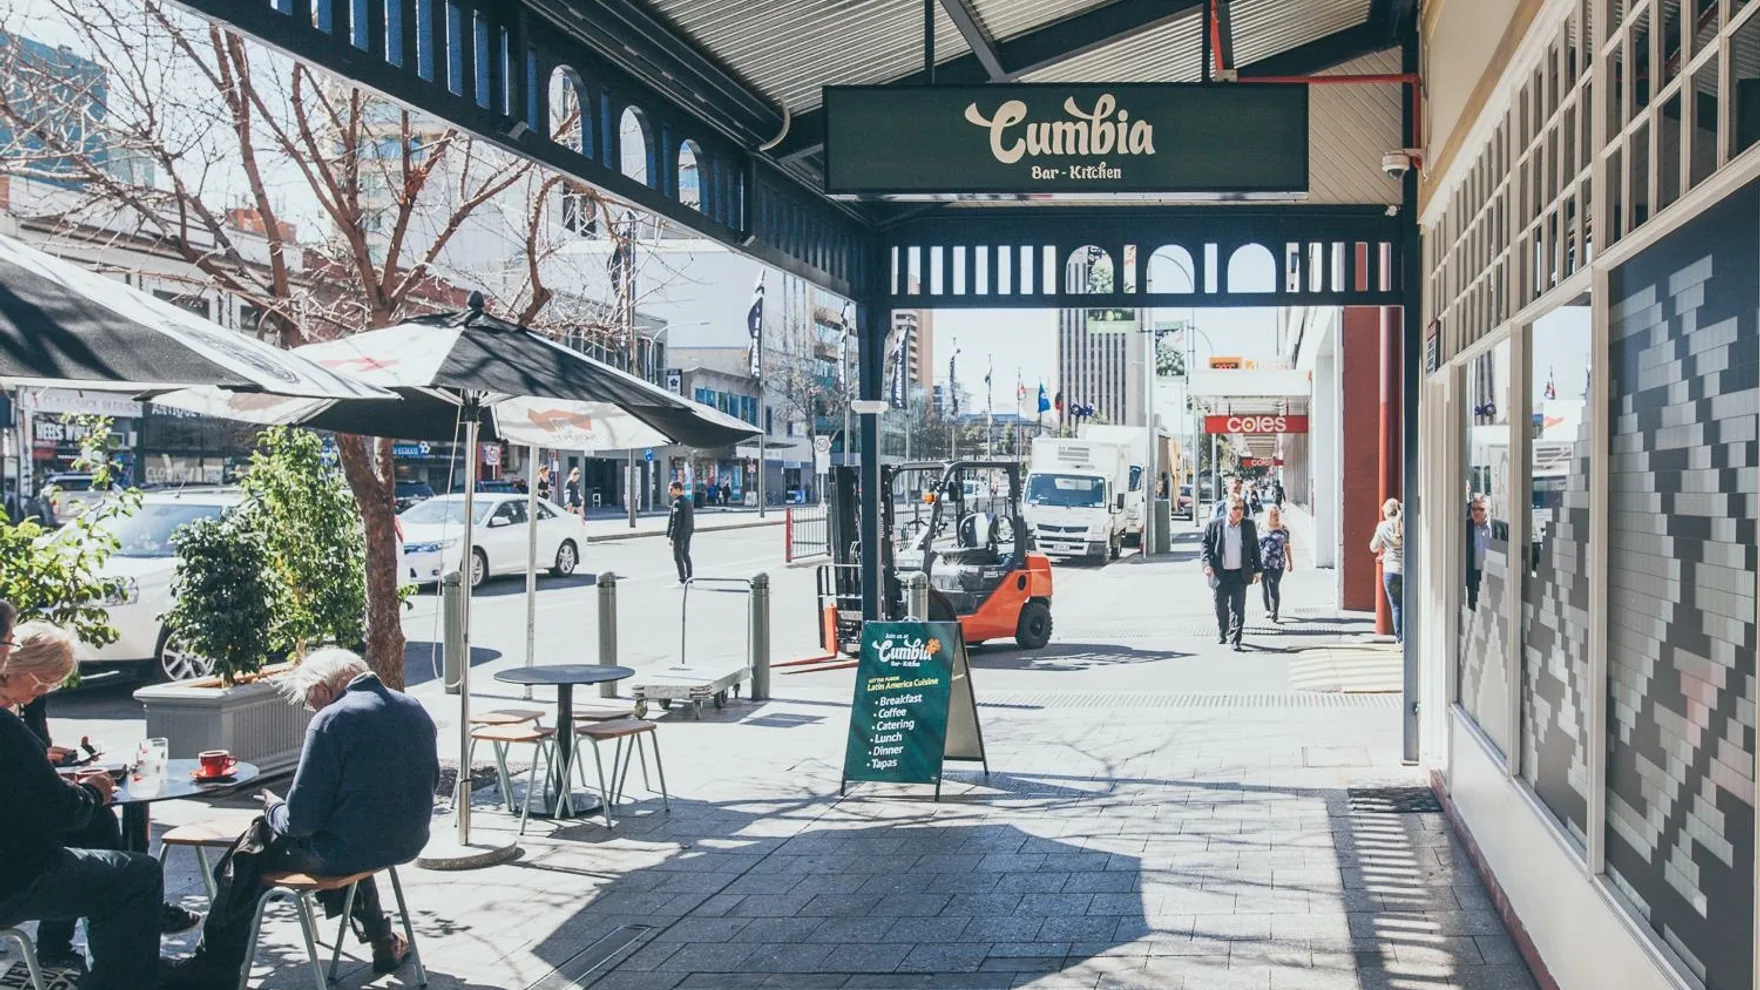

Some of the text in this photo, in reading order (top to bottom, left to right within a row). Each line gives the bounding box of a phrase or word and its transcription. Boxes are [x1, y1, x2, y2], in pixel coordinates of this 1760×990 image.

[965, 94, 1155, 164] Cumbia
[1031, 166, 1059, 179] Bar
[1070, 162, 1122, 179] Kitchen
[1227, 416, 1287, 433] coles
[872, 638, 932, 662] Cumbia
[867, 682, 884, 692] Latin
[885, 680, 913, 690] America
[914, 677, 939, 687] Cuisine
[880, 693, 922, 706] Breakfast
[878, 707, 907, 719] Coffee
[877, 717, 915, 731] Catering
[875, 731, 902, 743] Lunch
[873, 745, 904, 756] Dinner
[871, 758, 897, 770] Tapas
